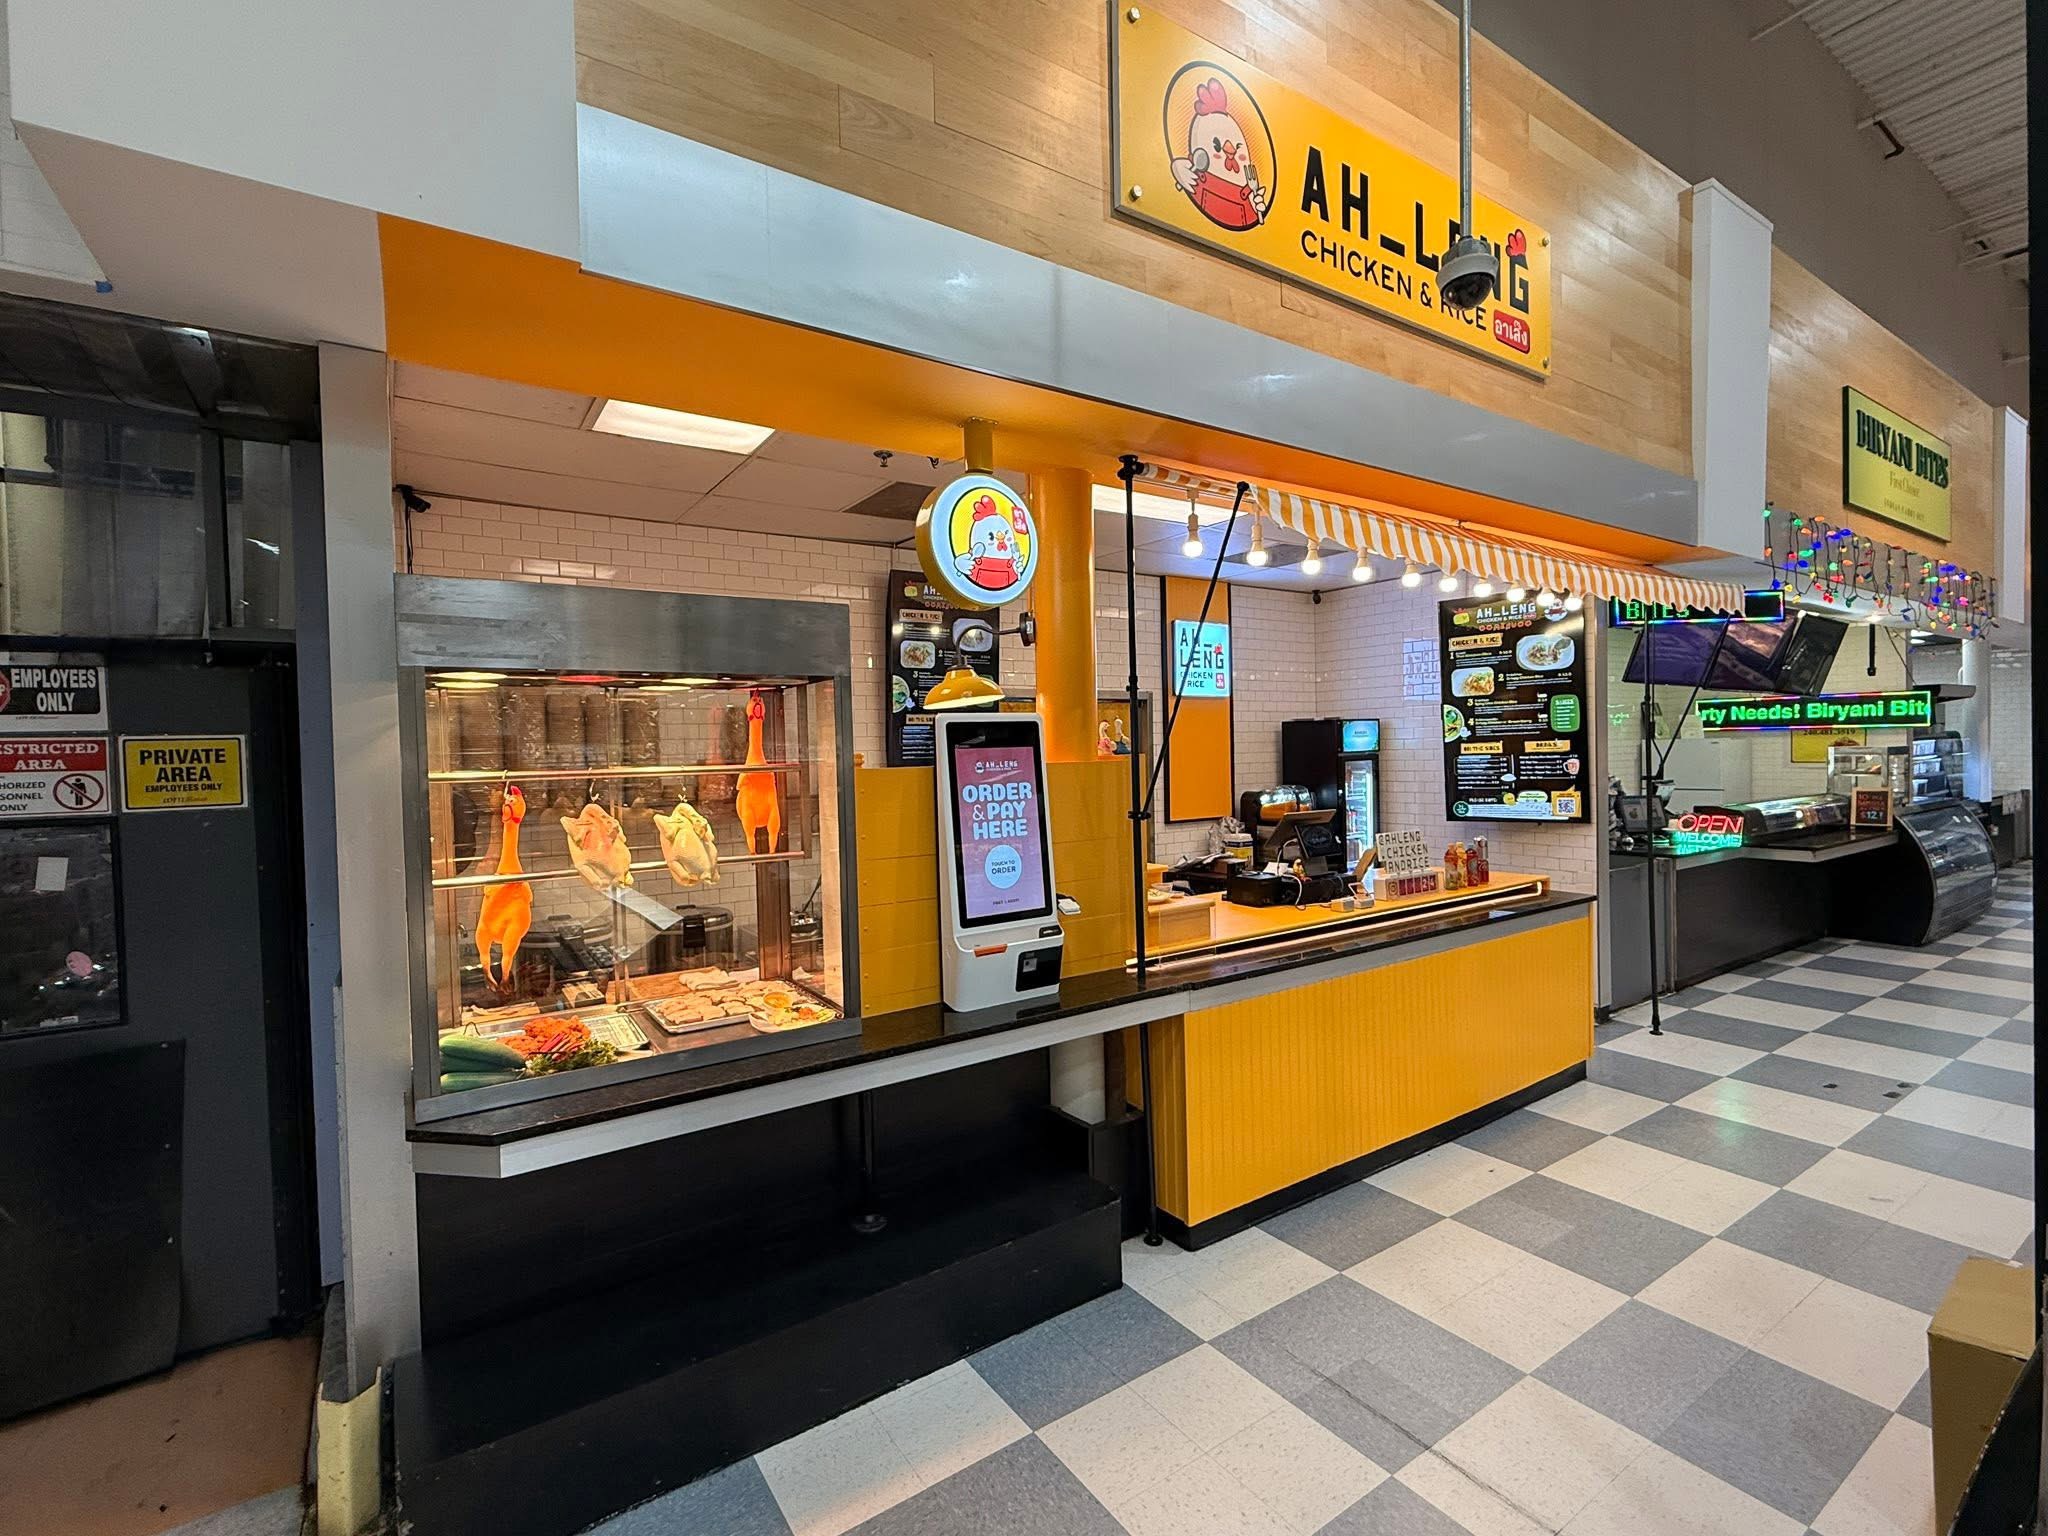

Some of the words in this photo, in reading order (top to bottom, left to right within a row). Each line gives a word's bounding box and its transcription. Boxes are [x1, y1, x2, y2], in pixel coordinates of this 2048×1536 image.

[1301, 230, 1412, 300] CHICKEN
[1420, 281, 1432, 309] &
[1856, 409, 1913, 472] BIRYANI
[1915, 442, 1949, 489] BITES
[1476, 602, 1536, 619] AH_LENG
[1180, 649, 1224, 669] LENG
[10, 668, 97, 688] EMPLOYEES
[1180, 671, 1214, 679] CICKEN
[1498, 673, 1505, 681] 2
[36, 692, 76, 712] ONLY
[1467, 698, 1474, 706] 3
[1731, 704, 1800, 720] Needs!
[1807, 701, 1884, 721] Biryani
[1467, 717, 1475, 726] 4
[14, 760, 68, 770] AREA
[140, 748, 227, 765] PRIVATE
[985, 760, 1018, 768] AH_LENG
[156, 766, 212, 782] AREA
[145, 784, 199, 793] EMPLOYEES
[201, 783, 222, 791] ONLY
[962, 782, 1033, 803] ORDER
[0, 803, 28, 812] ONLY
[972, 804, 985, 821] &
[987, 800, 1026, 820] PAY
[972, 818, 1029, 840] HERE
[1677, 814, 1742, 834] OPEN
[1378, 831, 1421, 846] @AHLENG
[991, 866, 1017, 874] ORDER
[1388, 856, 1430, 873] ANDRICE
